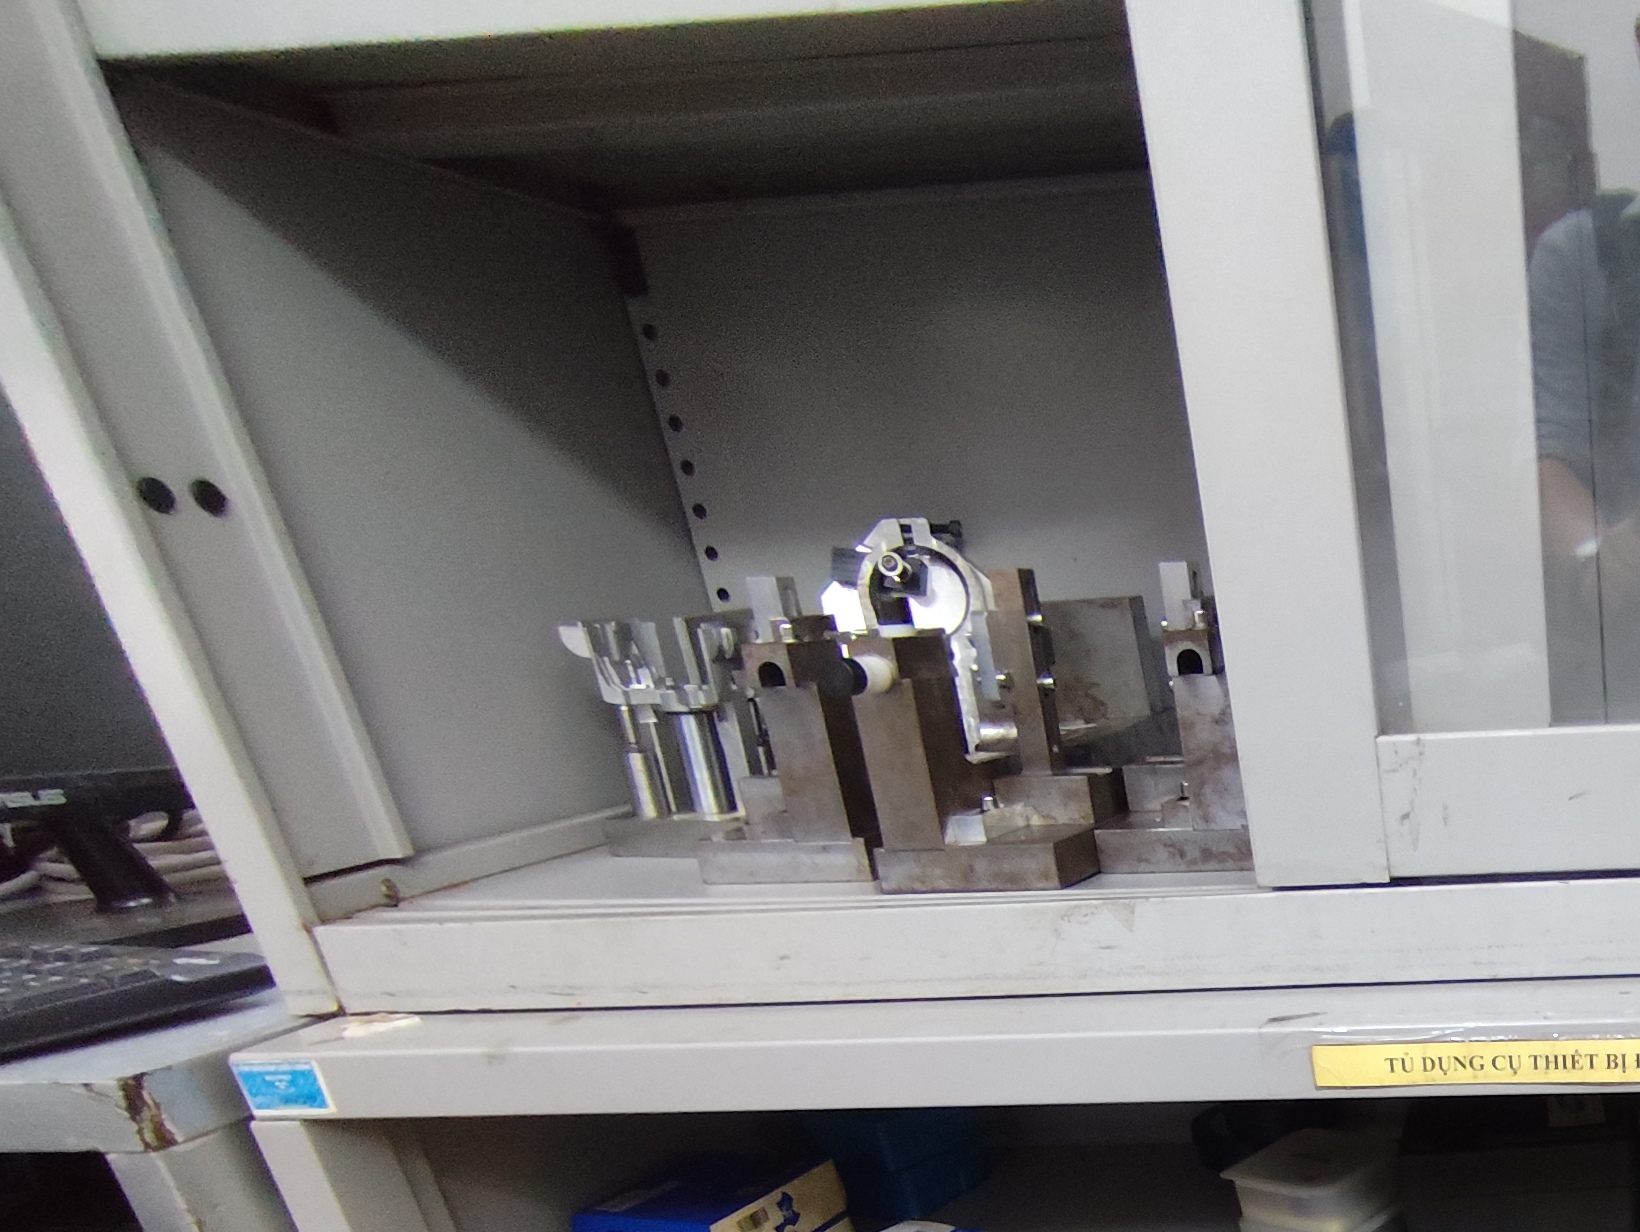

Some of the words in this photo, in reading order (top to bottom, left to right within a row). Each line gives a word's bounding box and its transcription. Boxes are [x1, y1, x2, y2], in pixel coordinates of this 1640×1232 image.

[1383, 1051, 1414, 1074] TỦ
[1421, 1054, 1485, 1076] DỤNG
[1491, 1054, 1522, 1076] CỤ
[1605, 1053, 1627, 1074] BỊ
